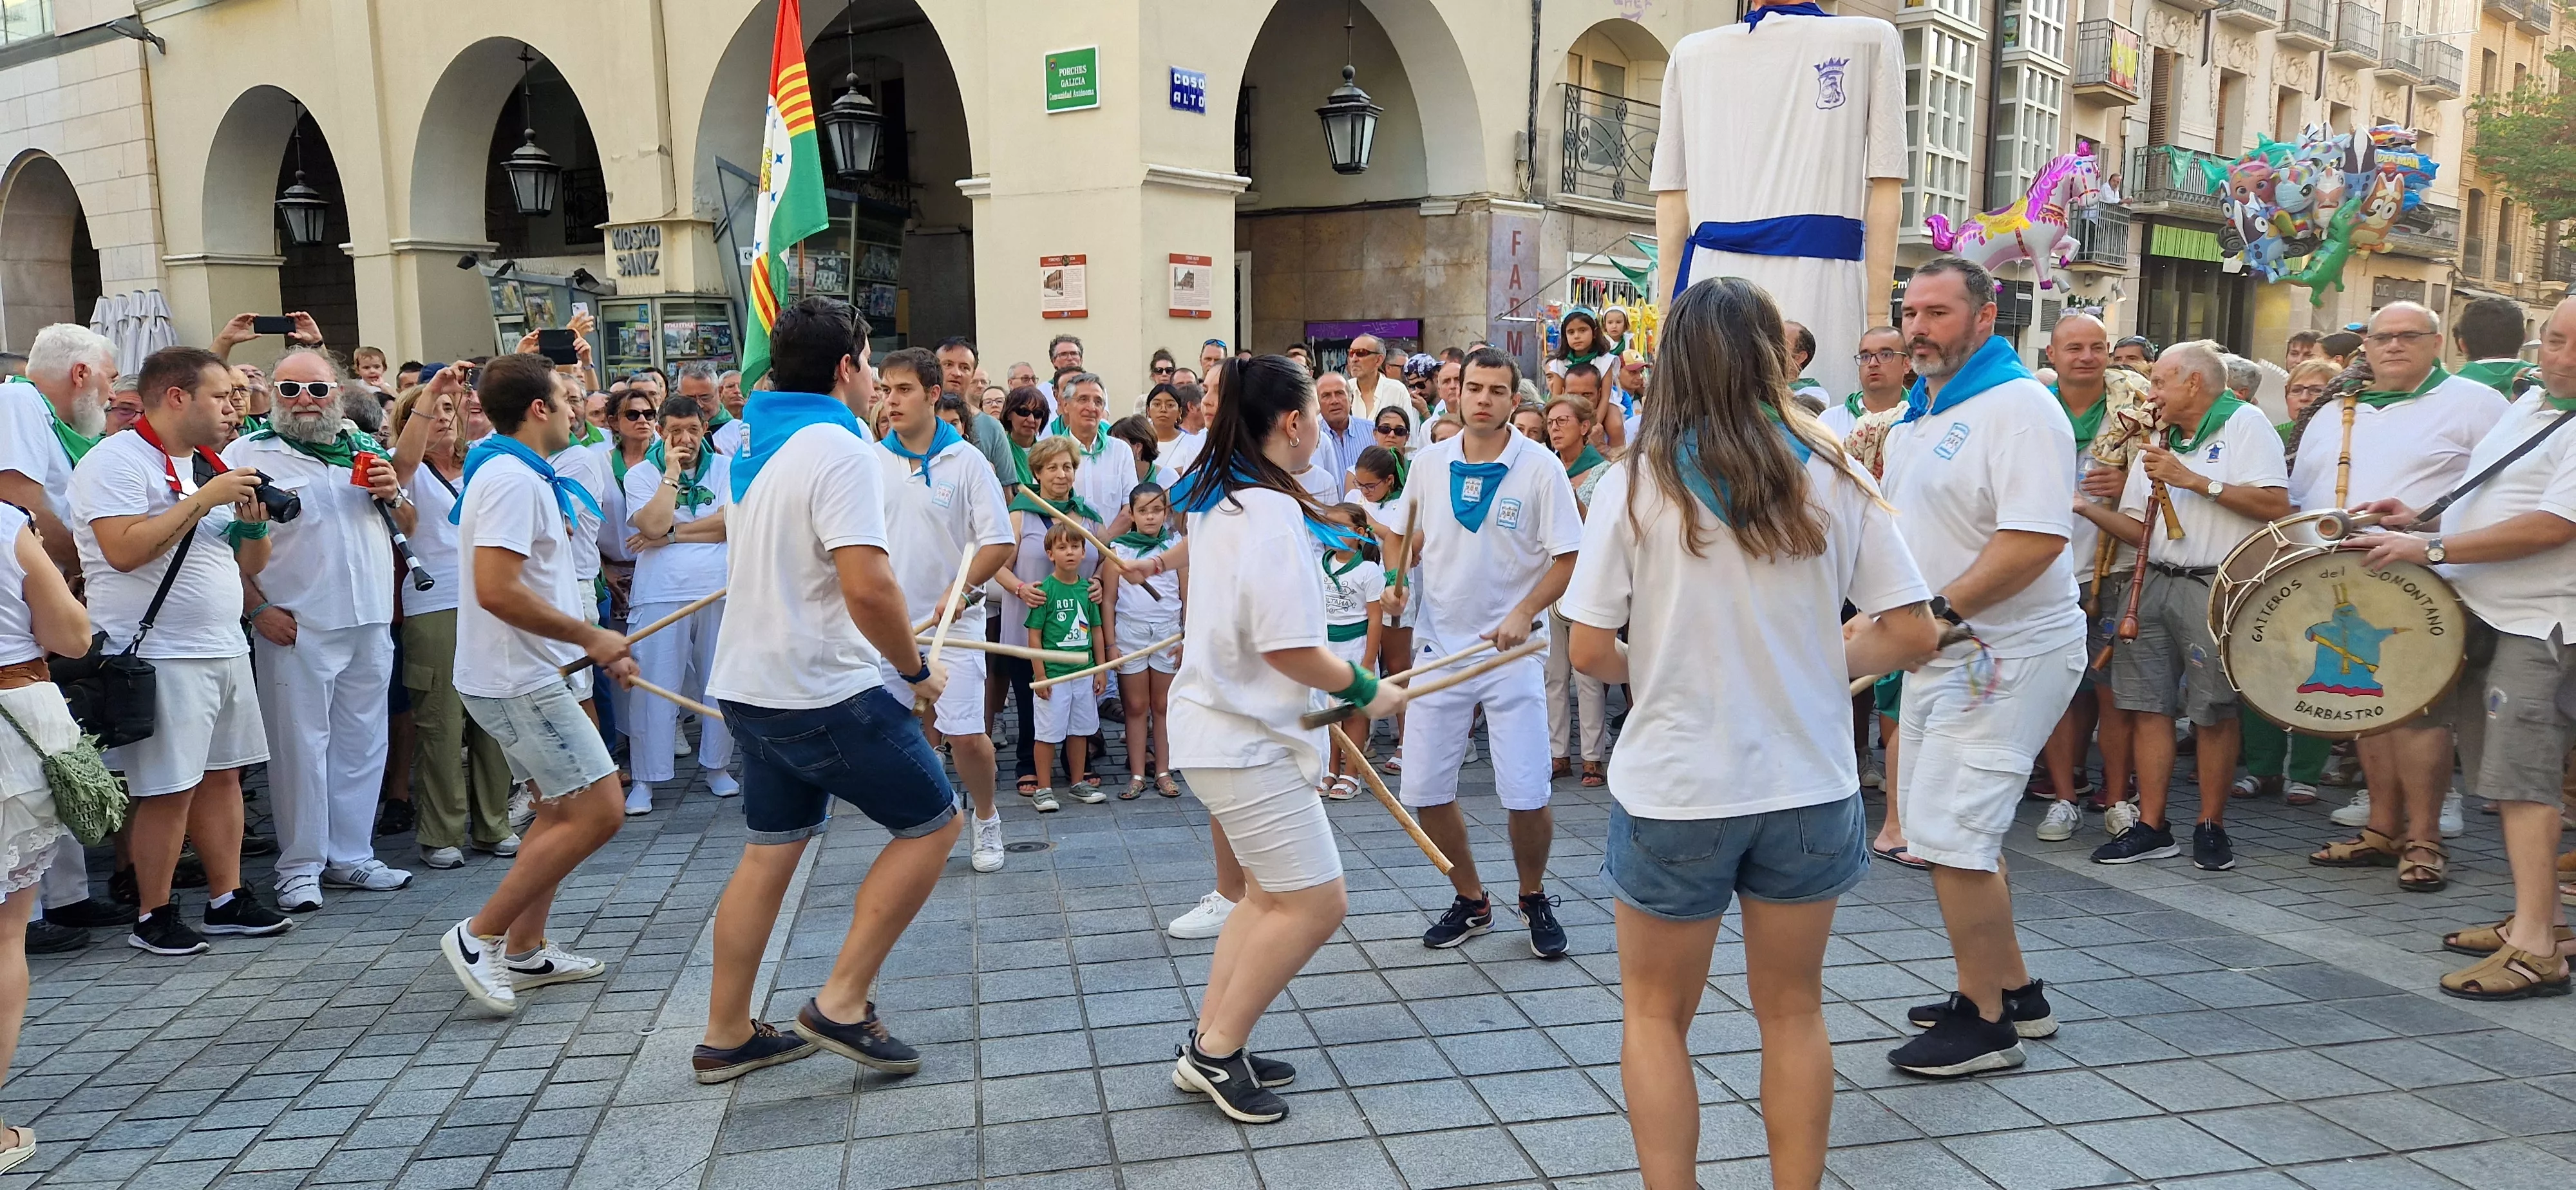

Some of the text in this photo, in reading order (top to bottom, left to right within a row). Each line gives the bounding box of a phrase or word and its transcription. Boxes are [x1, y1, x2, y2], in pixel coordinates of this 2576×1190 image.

[1059, 64, 1087, 77] PORCHES
[1061, 77, 1085, 88] GALICIA
[1174, 73, 1204, 90] COSO
[1049, 90, 1072, 100] Comunidad
[1173, 91, 1204, 108] ALTO
[611, 225, 661, 250] KIOSKO
[616, 250, 659, 277] SANZ
[1056, 599, 1074, 609] RGT
[2251, 580, 2302, 643] GAITEROS
[2320, 566, 2345, 578] del
[1068, 628, 1079, 639] 53
[2294, 701, 2384, 721] BARBASTRO
